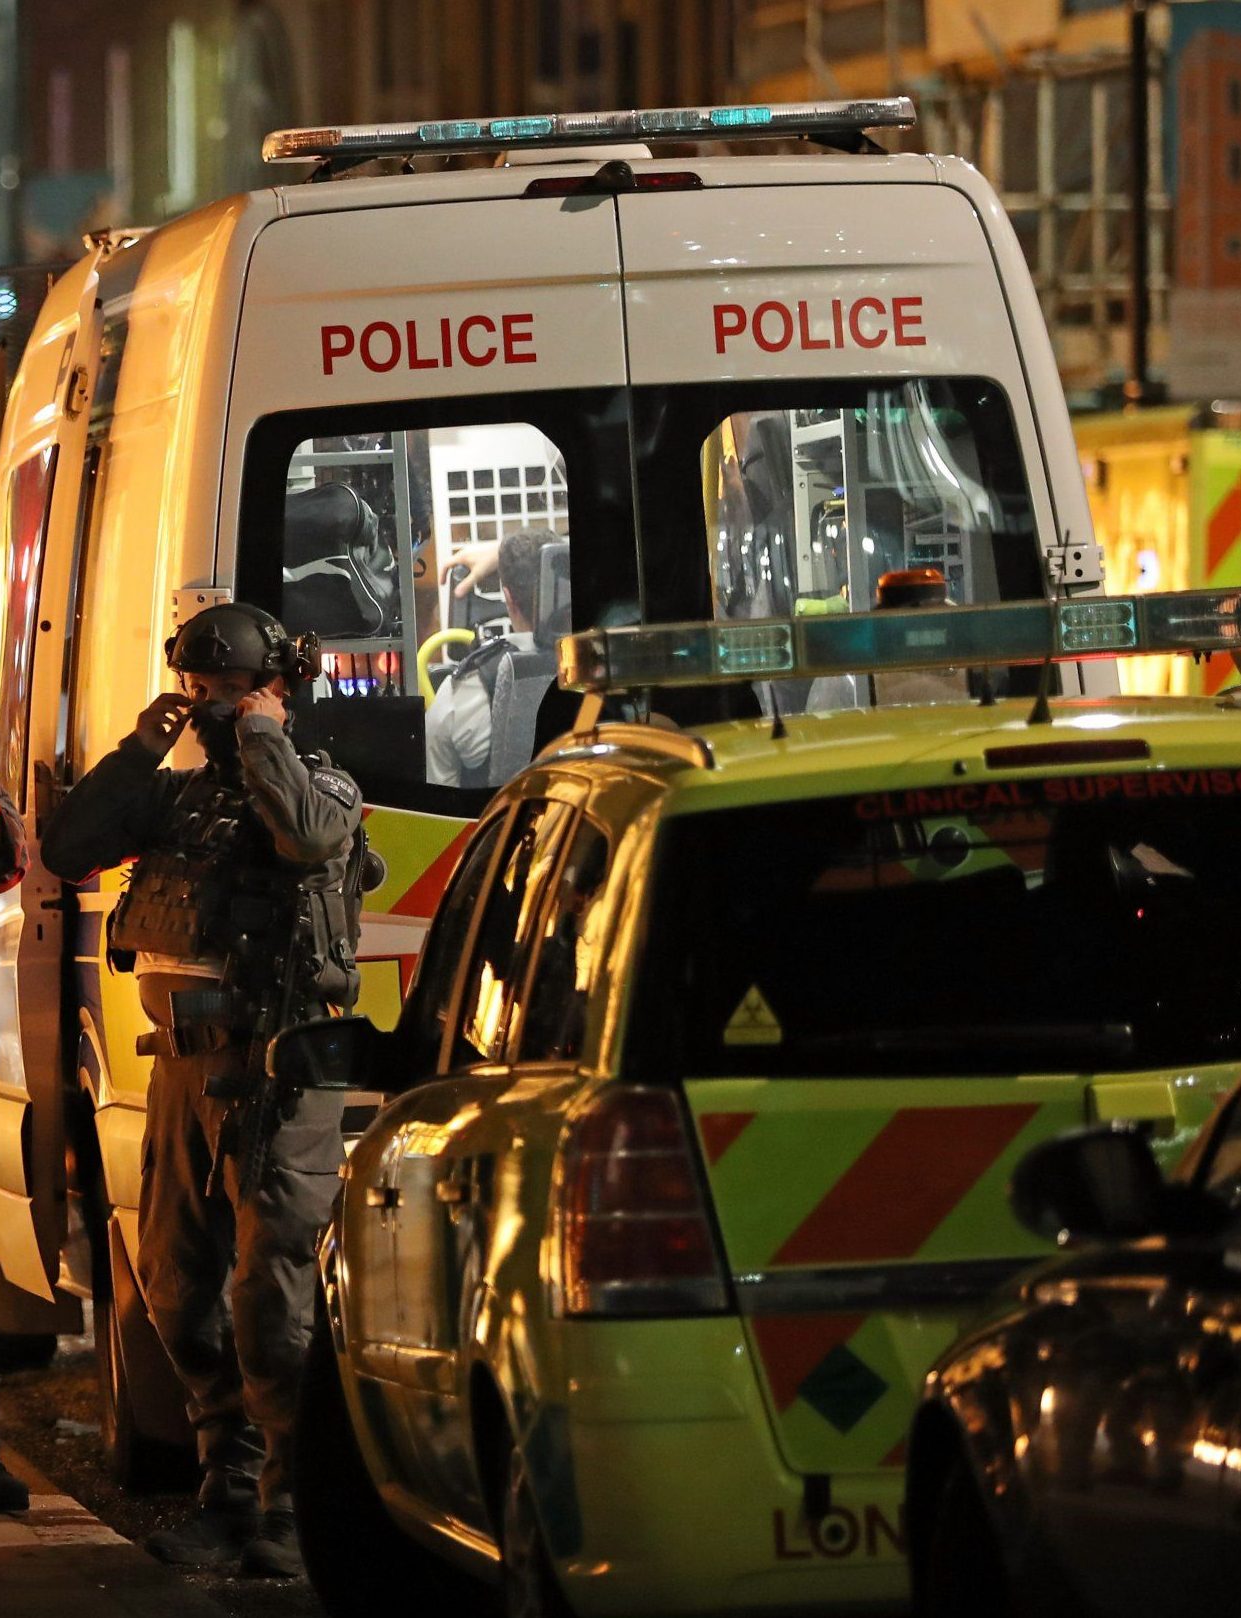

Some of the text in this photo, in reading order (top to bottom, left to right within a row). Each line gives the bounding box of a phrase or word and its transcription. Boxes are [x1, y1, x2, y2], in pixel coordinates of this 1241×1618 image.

[321, 312, 537, 375] POLICE
[713, 296, 926, 354] POLICE
[314, 771, 355, 797] POLICE
[855, 767, 1241, 820] CLINICAL SUPERVIS
[773, 1503, 910, 1560] LON
